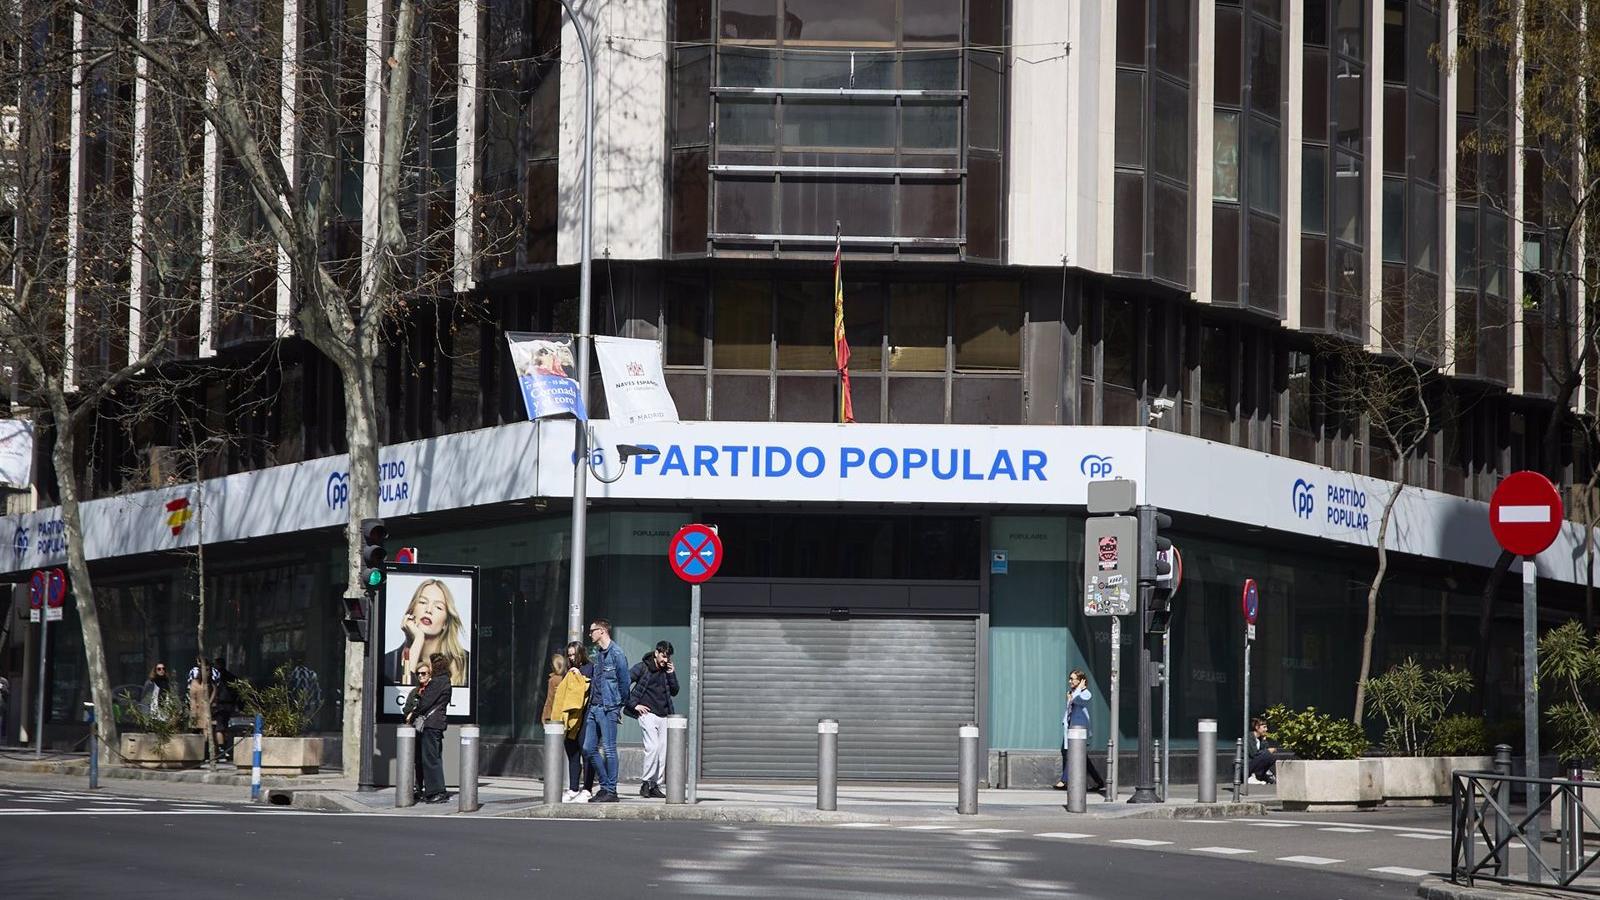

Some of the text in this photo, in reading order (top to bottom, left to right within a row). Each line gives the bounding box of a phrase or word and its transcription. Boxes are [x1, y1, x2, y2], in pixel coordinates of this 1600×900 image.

[634, 444, 1048, 481] PARTIDO POPULAR
[1327, 484, 1366, 509] PARTIDO
[1327, 506, 1369, 531] POPULAR
[38, 539, 65, 555] POPULA
